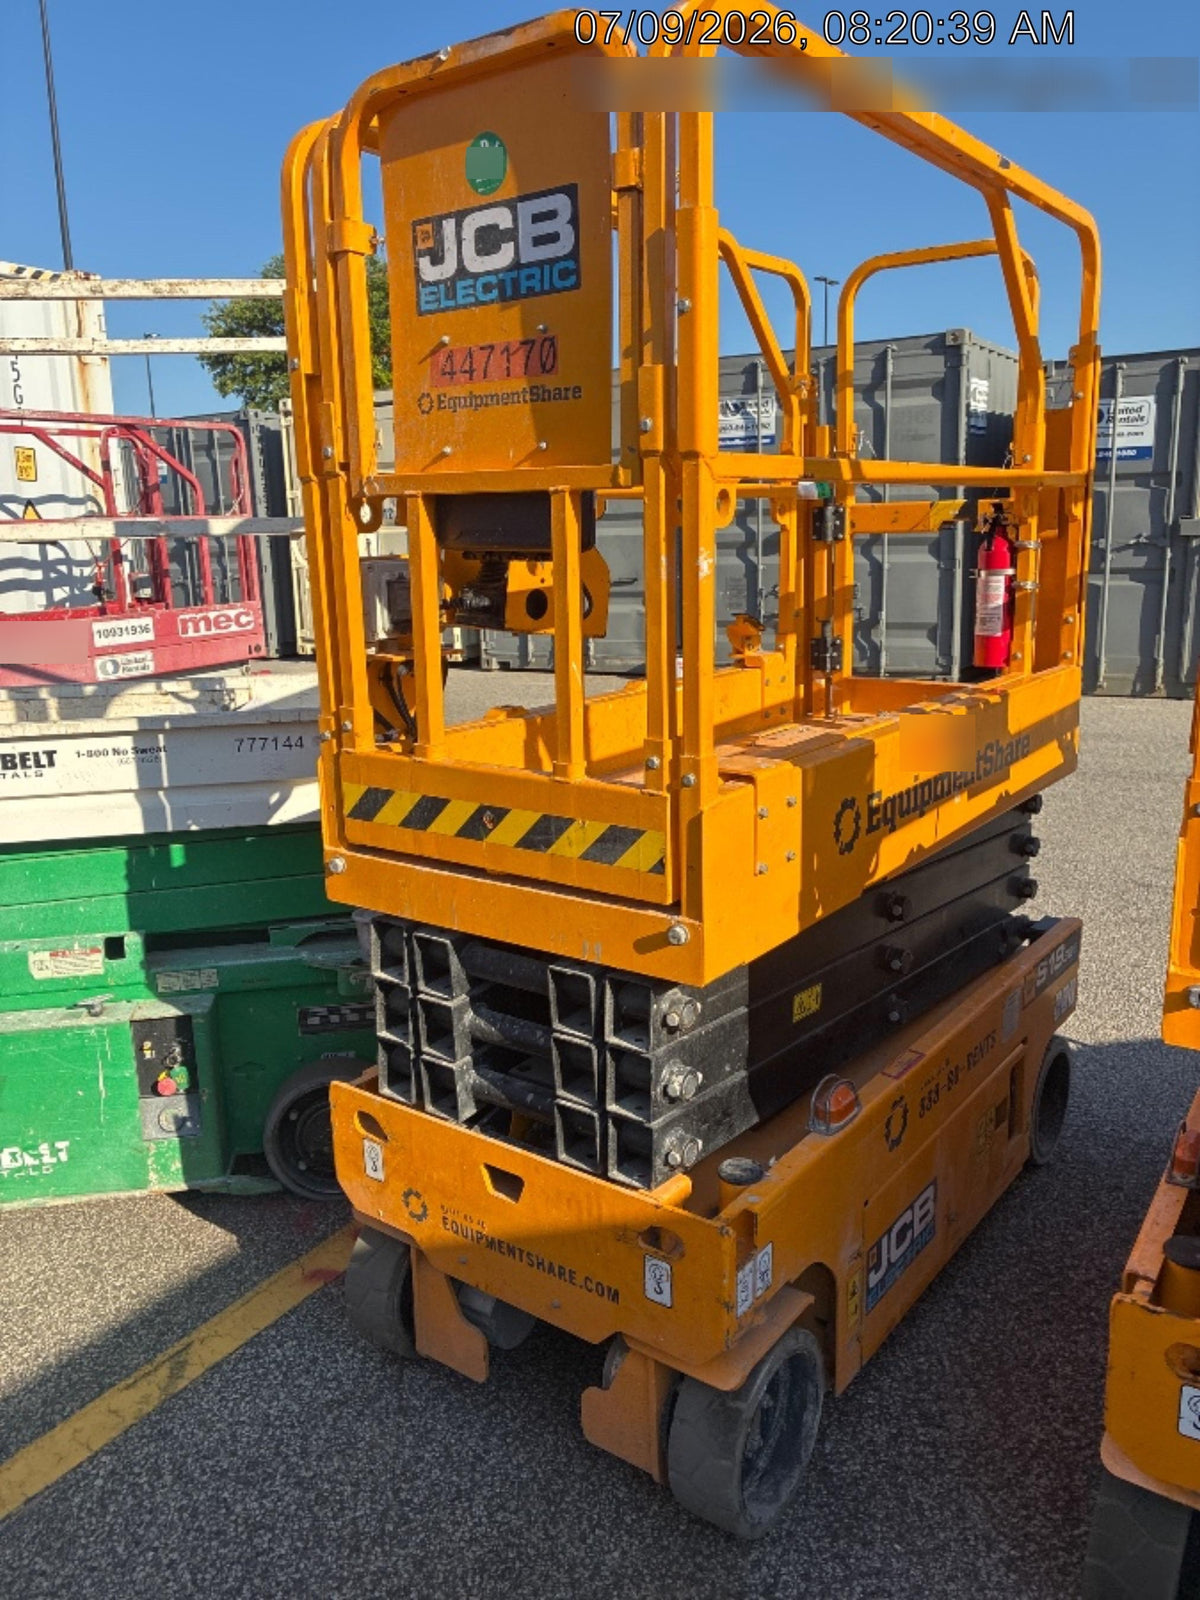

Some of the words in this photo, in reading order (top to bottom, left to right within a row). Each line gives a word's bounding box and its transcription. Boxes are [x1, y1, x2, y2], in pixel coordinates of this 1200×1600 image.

[418, 193, 575, 282] JCB
[419, 260, 577, 312] ELECTRIC
[440, 335, 556, 382] 447170
[436, 385, 583, 413] EquipmentShare
[1105, 414, 1146, 424] Rntals
[96, 624, 151, 639] 10931936
[178, 611, 254, 635] mec
[75, 749, 109, 759] 1-800
[112, 747, 128, 756] No
[131, 744, 168, 755] Sweat
[234, 735, 305, 753] 777144
[868, 1185, 935, 1290] JCB
[442, 1206, 621, 1305] EQUIPMENTSHARE.COM
